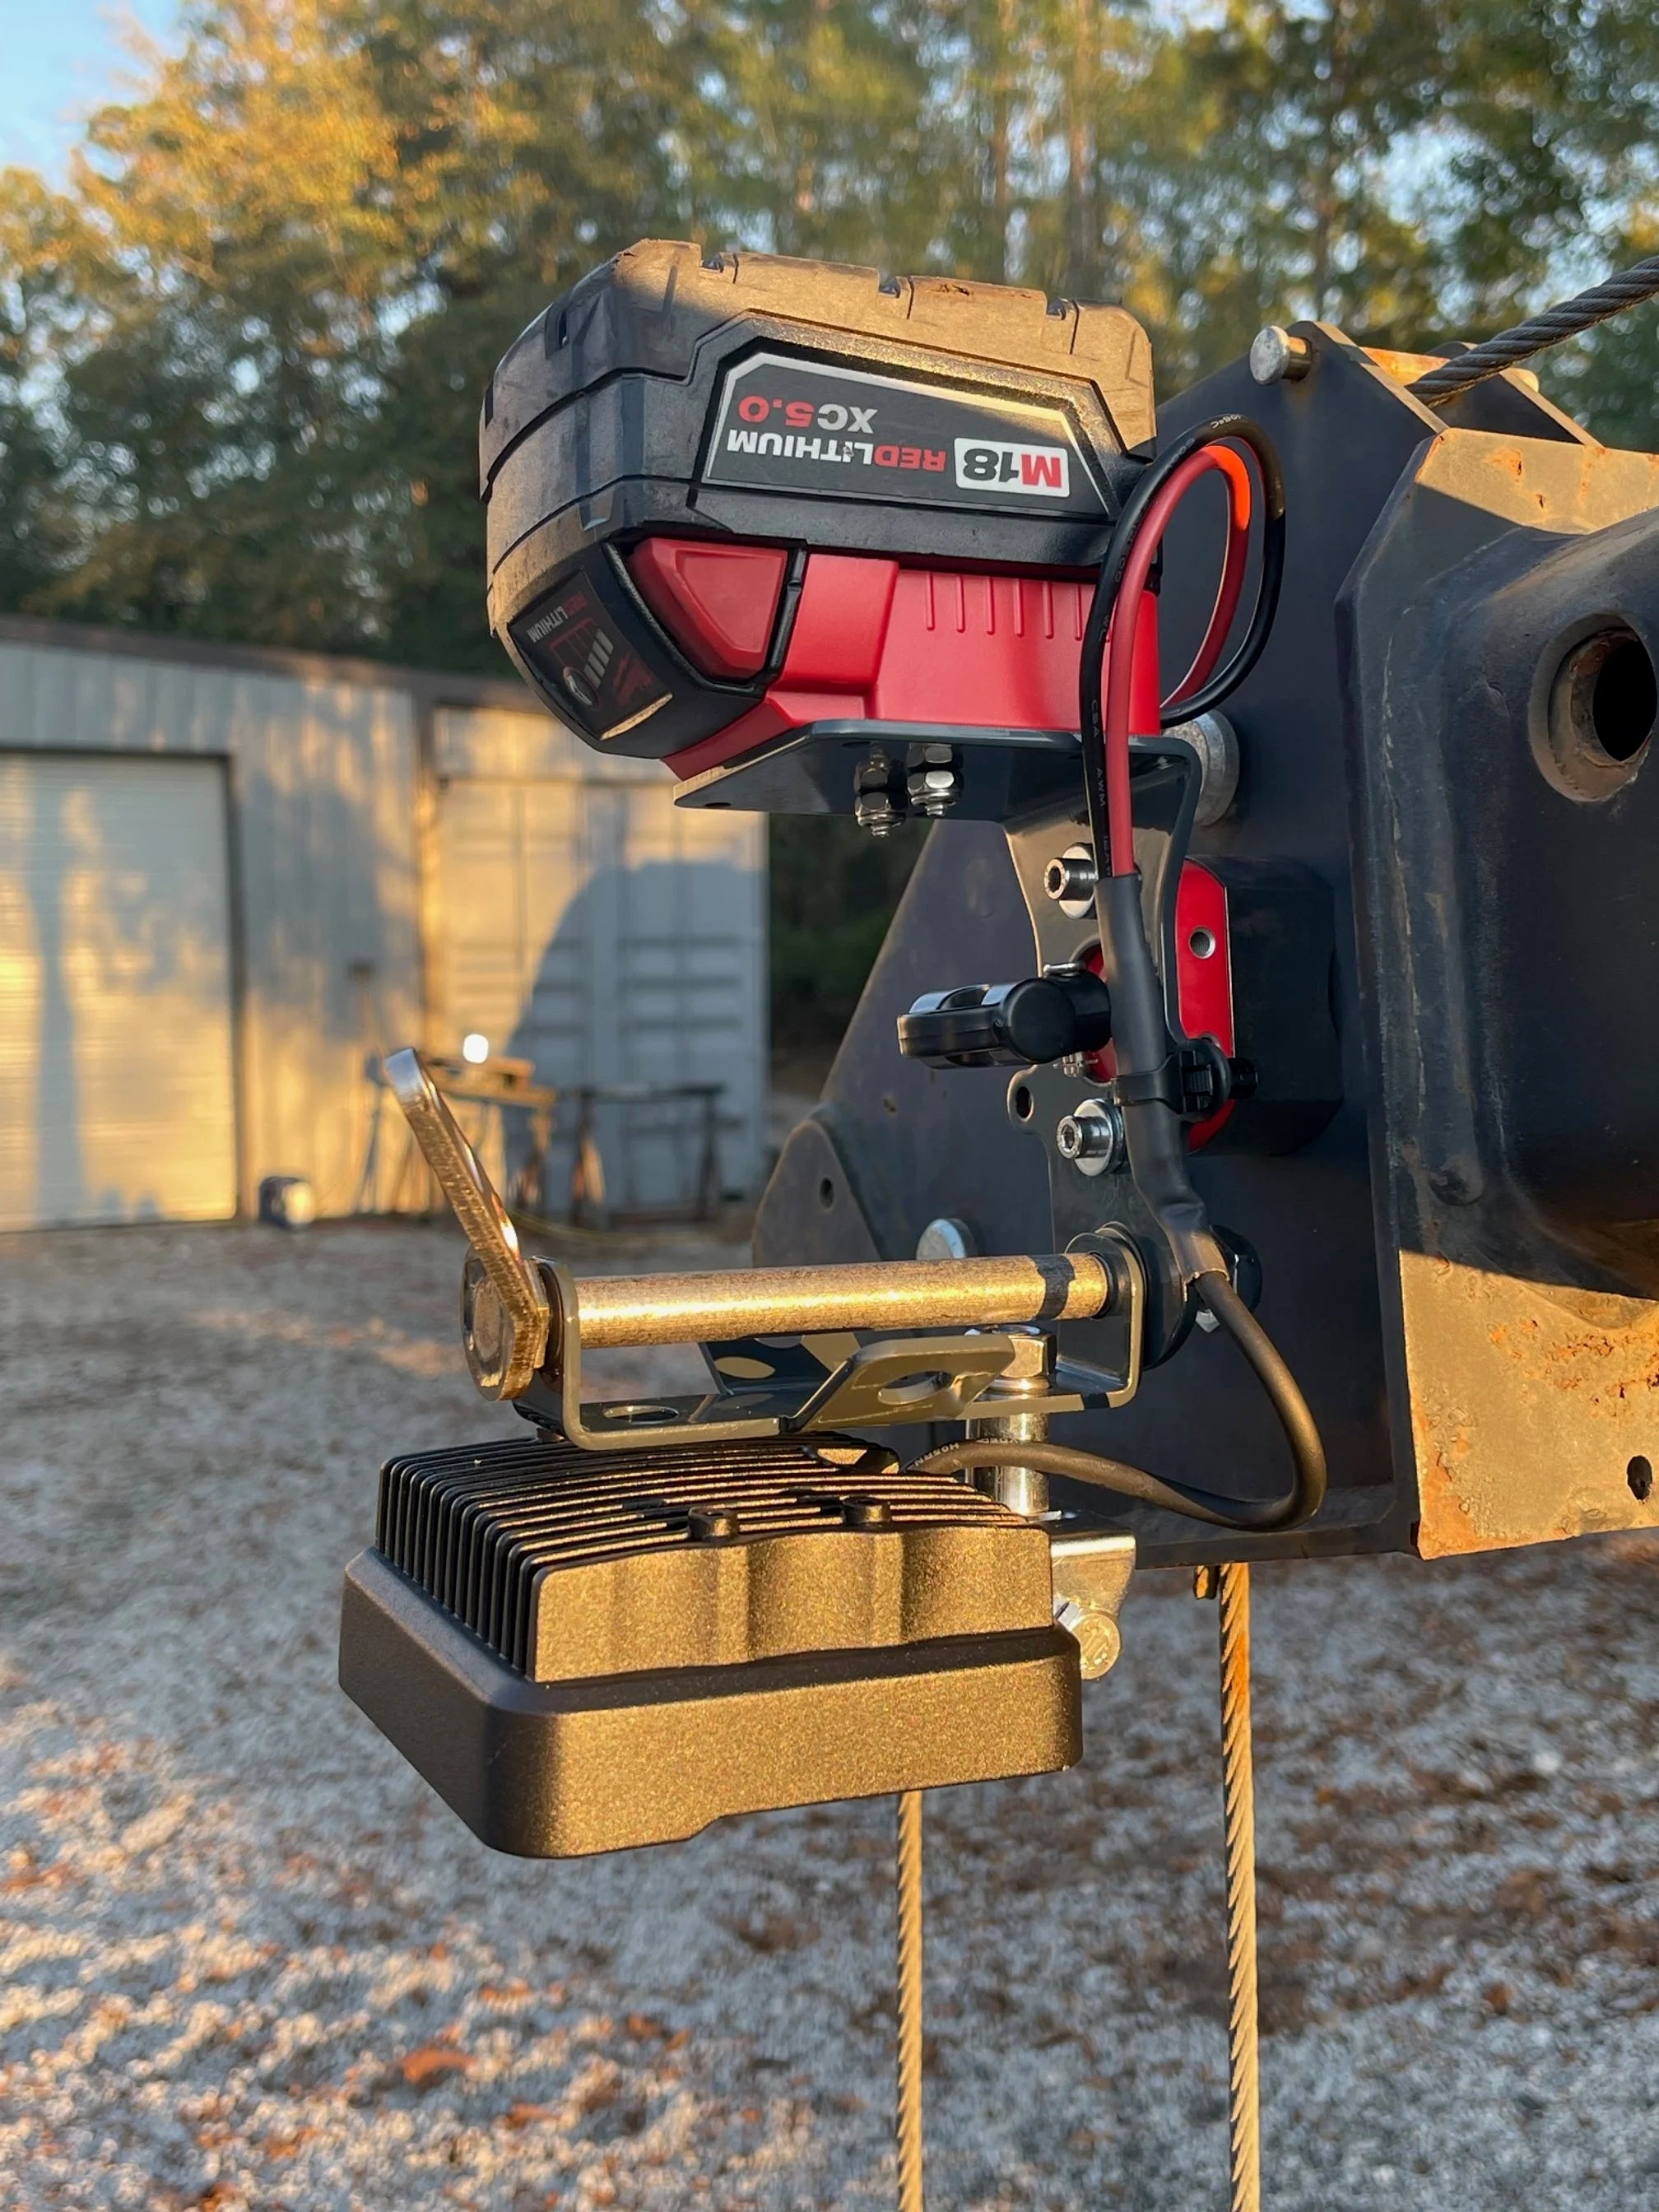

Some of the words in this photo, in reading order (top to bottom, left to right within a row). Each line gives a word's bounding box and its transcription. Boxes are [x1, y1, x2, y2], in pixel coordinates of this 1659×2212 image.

[738, 394, 878, 434] XC5.0
[727, 429, 946, 472] REDLITHIUM
[963, 448, 1062, 489] M18
